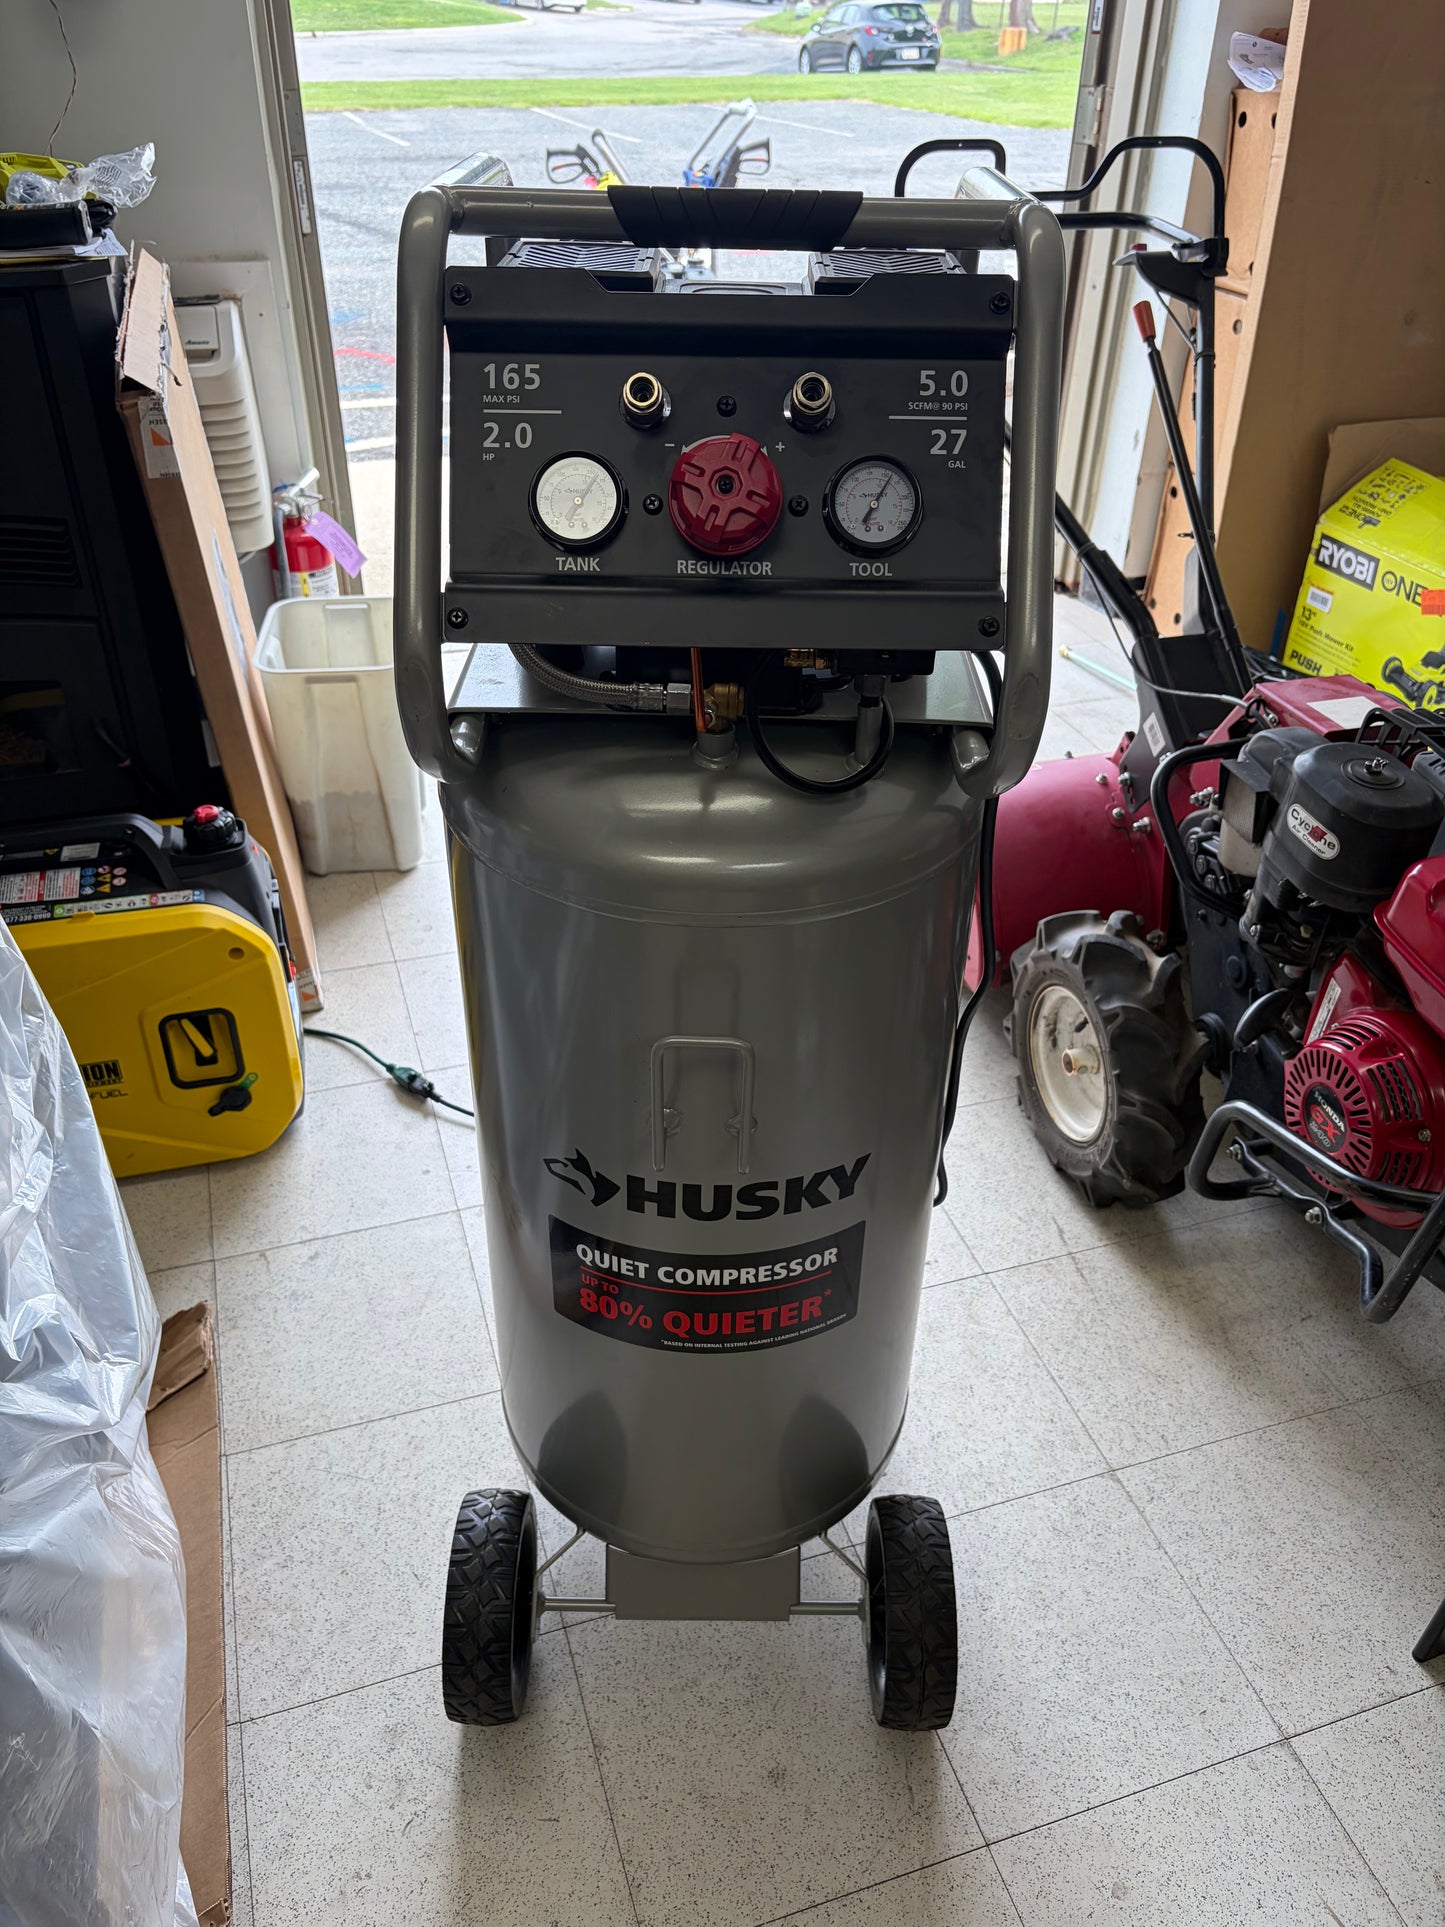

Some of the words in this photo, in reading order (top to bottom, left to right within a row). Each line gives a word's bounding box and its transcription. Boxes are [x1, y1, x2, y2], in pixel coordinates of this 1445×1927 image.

[483, 363, 541, 390] 165
[920, 370, 968, 397] 5.0
[483, 395, 505, 403] MAX
[507, 395, 520, 403] PSI
[908, 402, 940, 410] SCFM@
[942, 402, 953, 410] 90
[955, 403, 968, 411] PSI
[483, 421, 533, 449] 2.0
[930, 429, 967, 455] 27
[483, 453, 495, 461] HP
[948, 460, 966, 469] GAL
[556, 557, 600, 571] TANK
[677, 559, 772, 575] REGULATOR
[849, 562, 893, 577] TOOL
[1318, 539, 1376, 585] RYOBI
[1344, 642, 1354, 652] Kit
[1290, 650, 1323, 676] PUSH
[1292, 824, 1301, 834] Air
[1302, 833, 1327, 855] Cleaner
[1310, 1104, 1341, 1144] GX
[1314, 1090, 1345, 1133] HONDA
[626, 1152, 872, 1221] HUSKY
[576, 1244, 649, 1279] QUIET
[657, 1246, 839, 1286] COMPRESSOR
[581, 1273, 599, 1287] UP
[600, 1281, 619, 1295] TO
[580, 1287, 653, 1329] 80%
[749, 1337, 774, 1346] AGAINST
[775, 1332, 800, 1341] LEADING
[800, 1323, 826, 1335] NATIONAL
